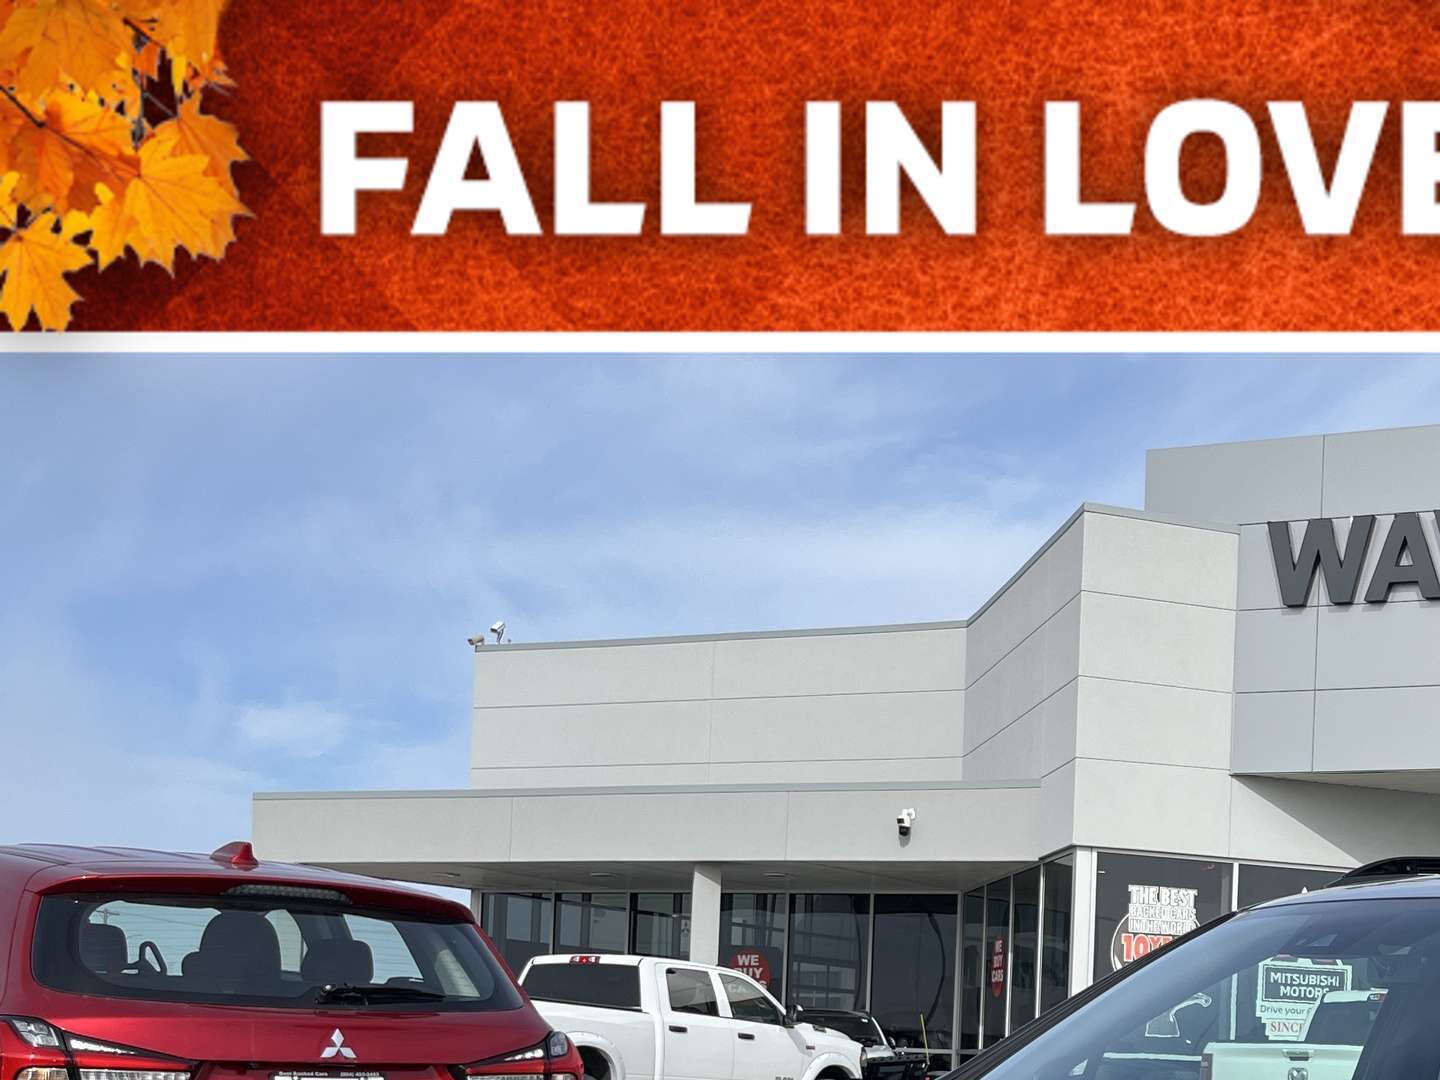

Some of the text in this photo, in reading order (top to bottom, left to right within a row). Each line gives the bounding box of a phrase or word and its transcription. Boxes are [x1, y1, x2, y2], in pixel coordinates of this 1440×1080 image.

[1128, 885, 1198, 908] THE BEST
[1129, 905, 1197, 920] BACKED CARS
[737, 954, 760, 966] WE
[733, 967, 763, 979] UY
[1270, 971, 1340, 987] MITSUBISHI
[1260, 1004, 1283, 1014] Drive
[1285, 1006, 1306, 1017] your
